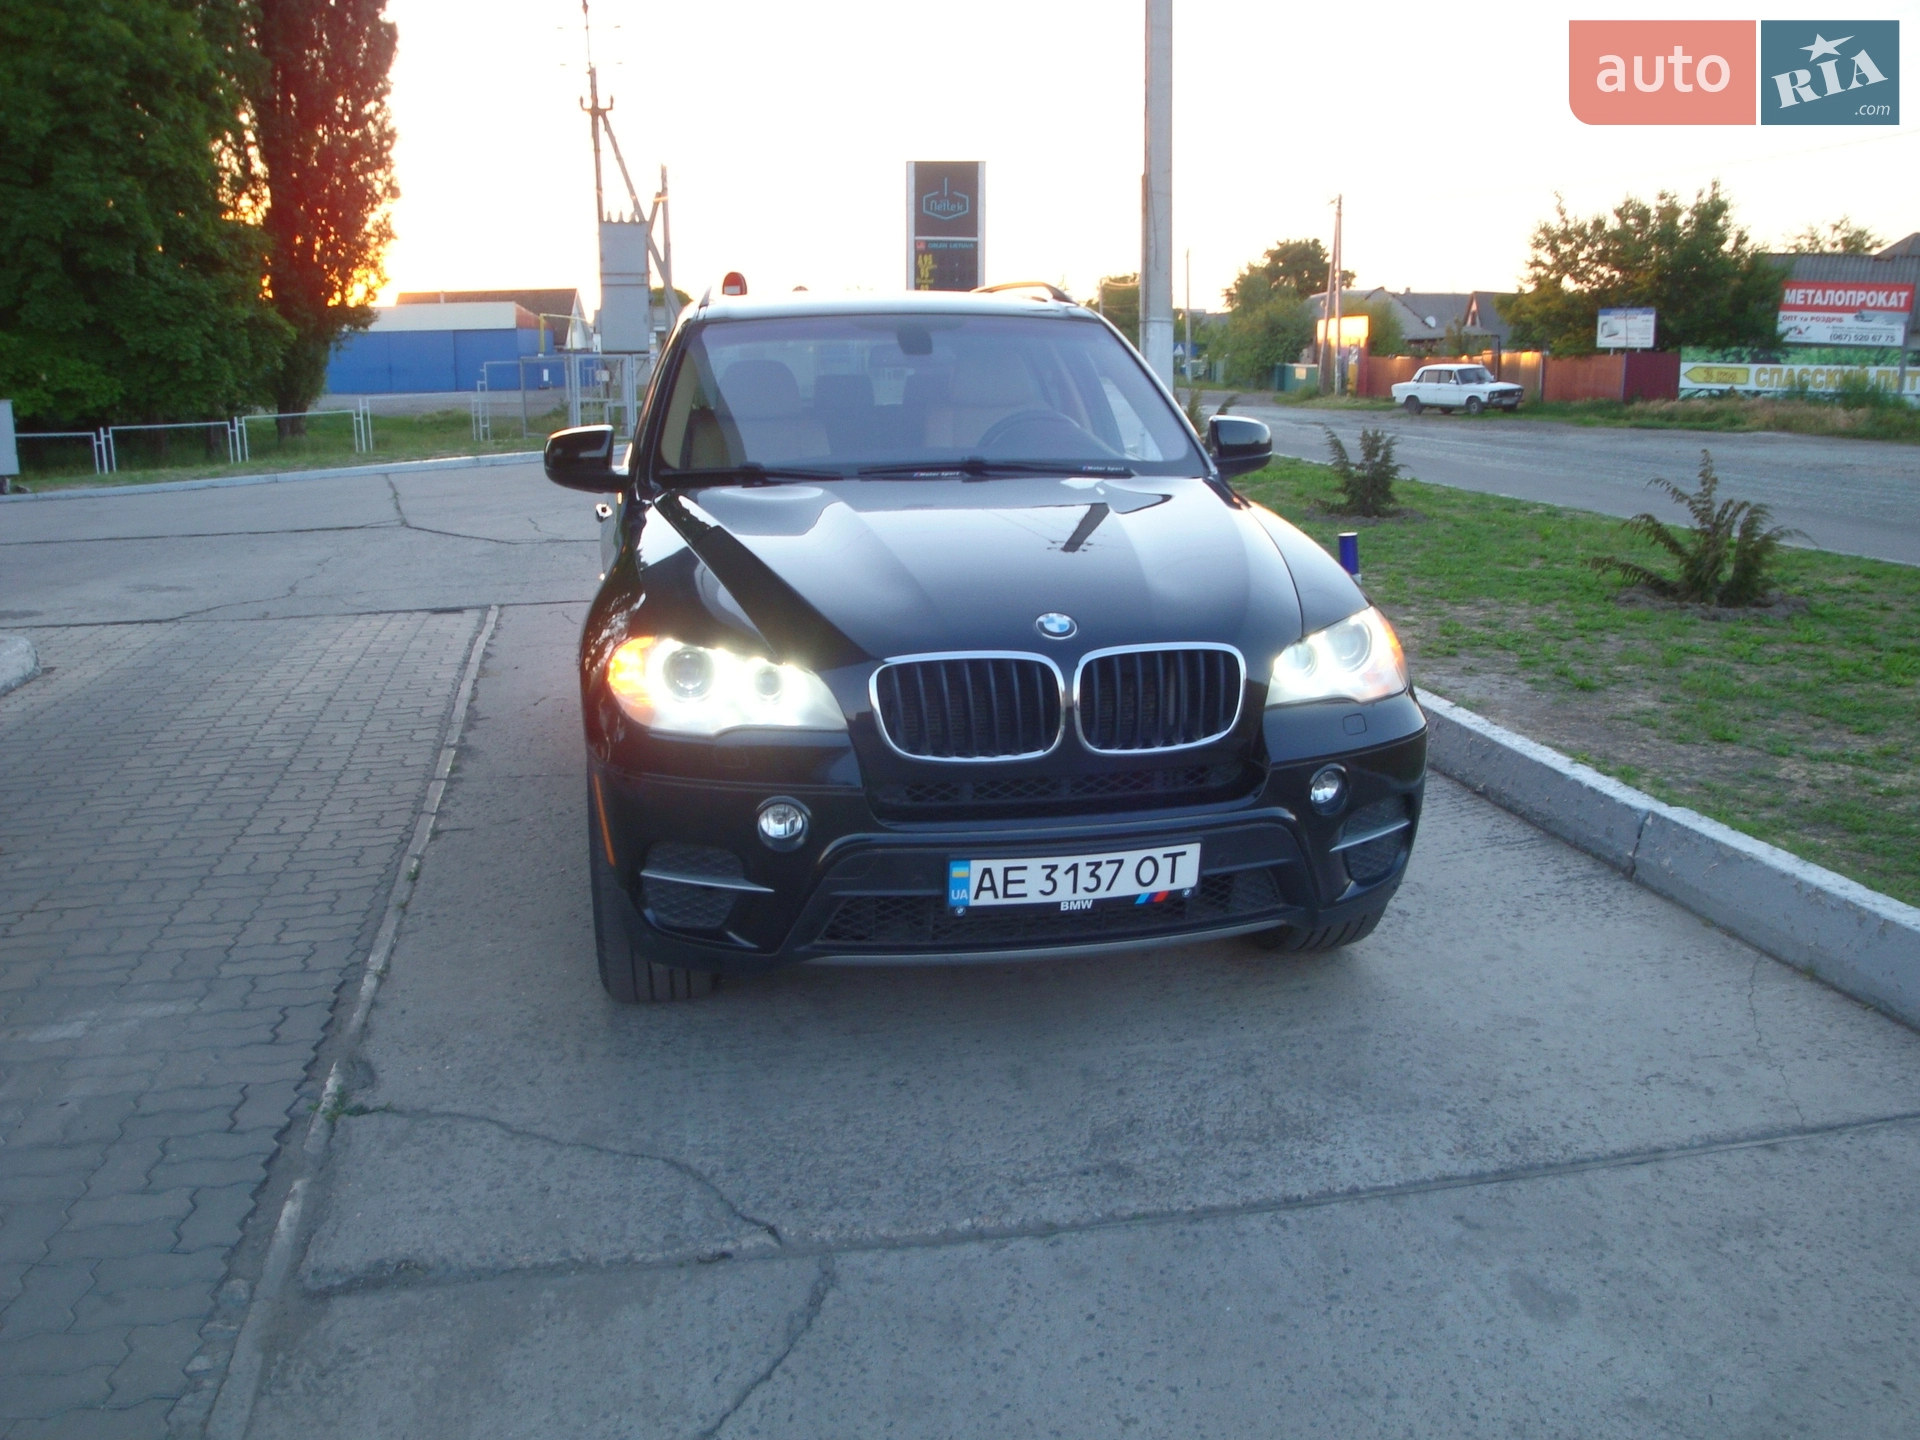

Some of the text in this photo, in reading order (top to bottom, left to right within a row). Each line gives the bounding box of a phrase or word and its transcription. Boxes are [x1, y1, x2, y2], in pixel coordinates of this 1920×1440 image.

[1783, 288, 1909, 308] МЕТАЛОПРОКАТ
[1782, 315, 1798, 323] ОПТ
[1829, 332, 1852, 342] (067)
[974, 850, 1187, 900] AE 3137 OT
[951, 889, 968, 900] UA
[1060, 899, 1093, 911] BMW
